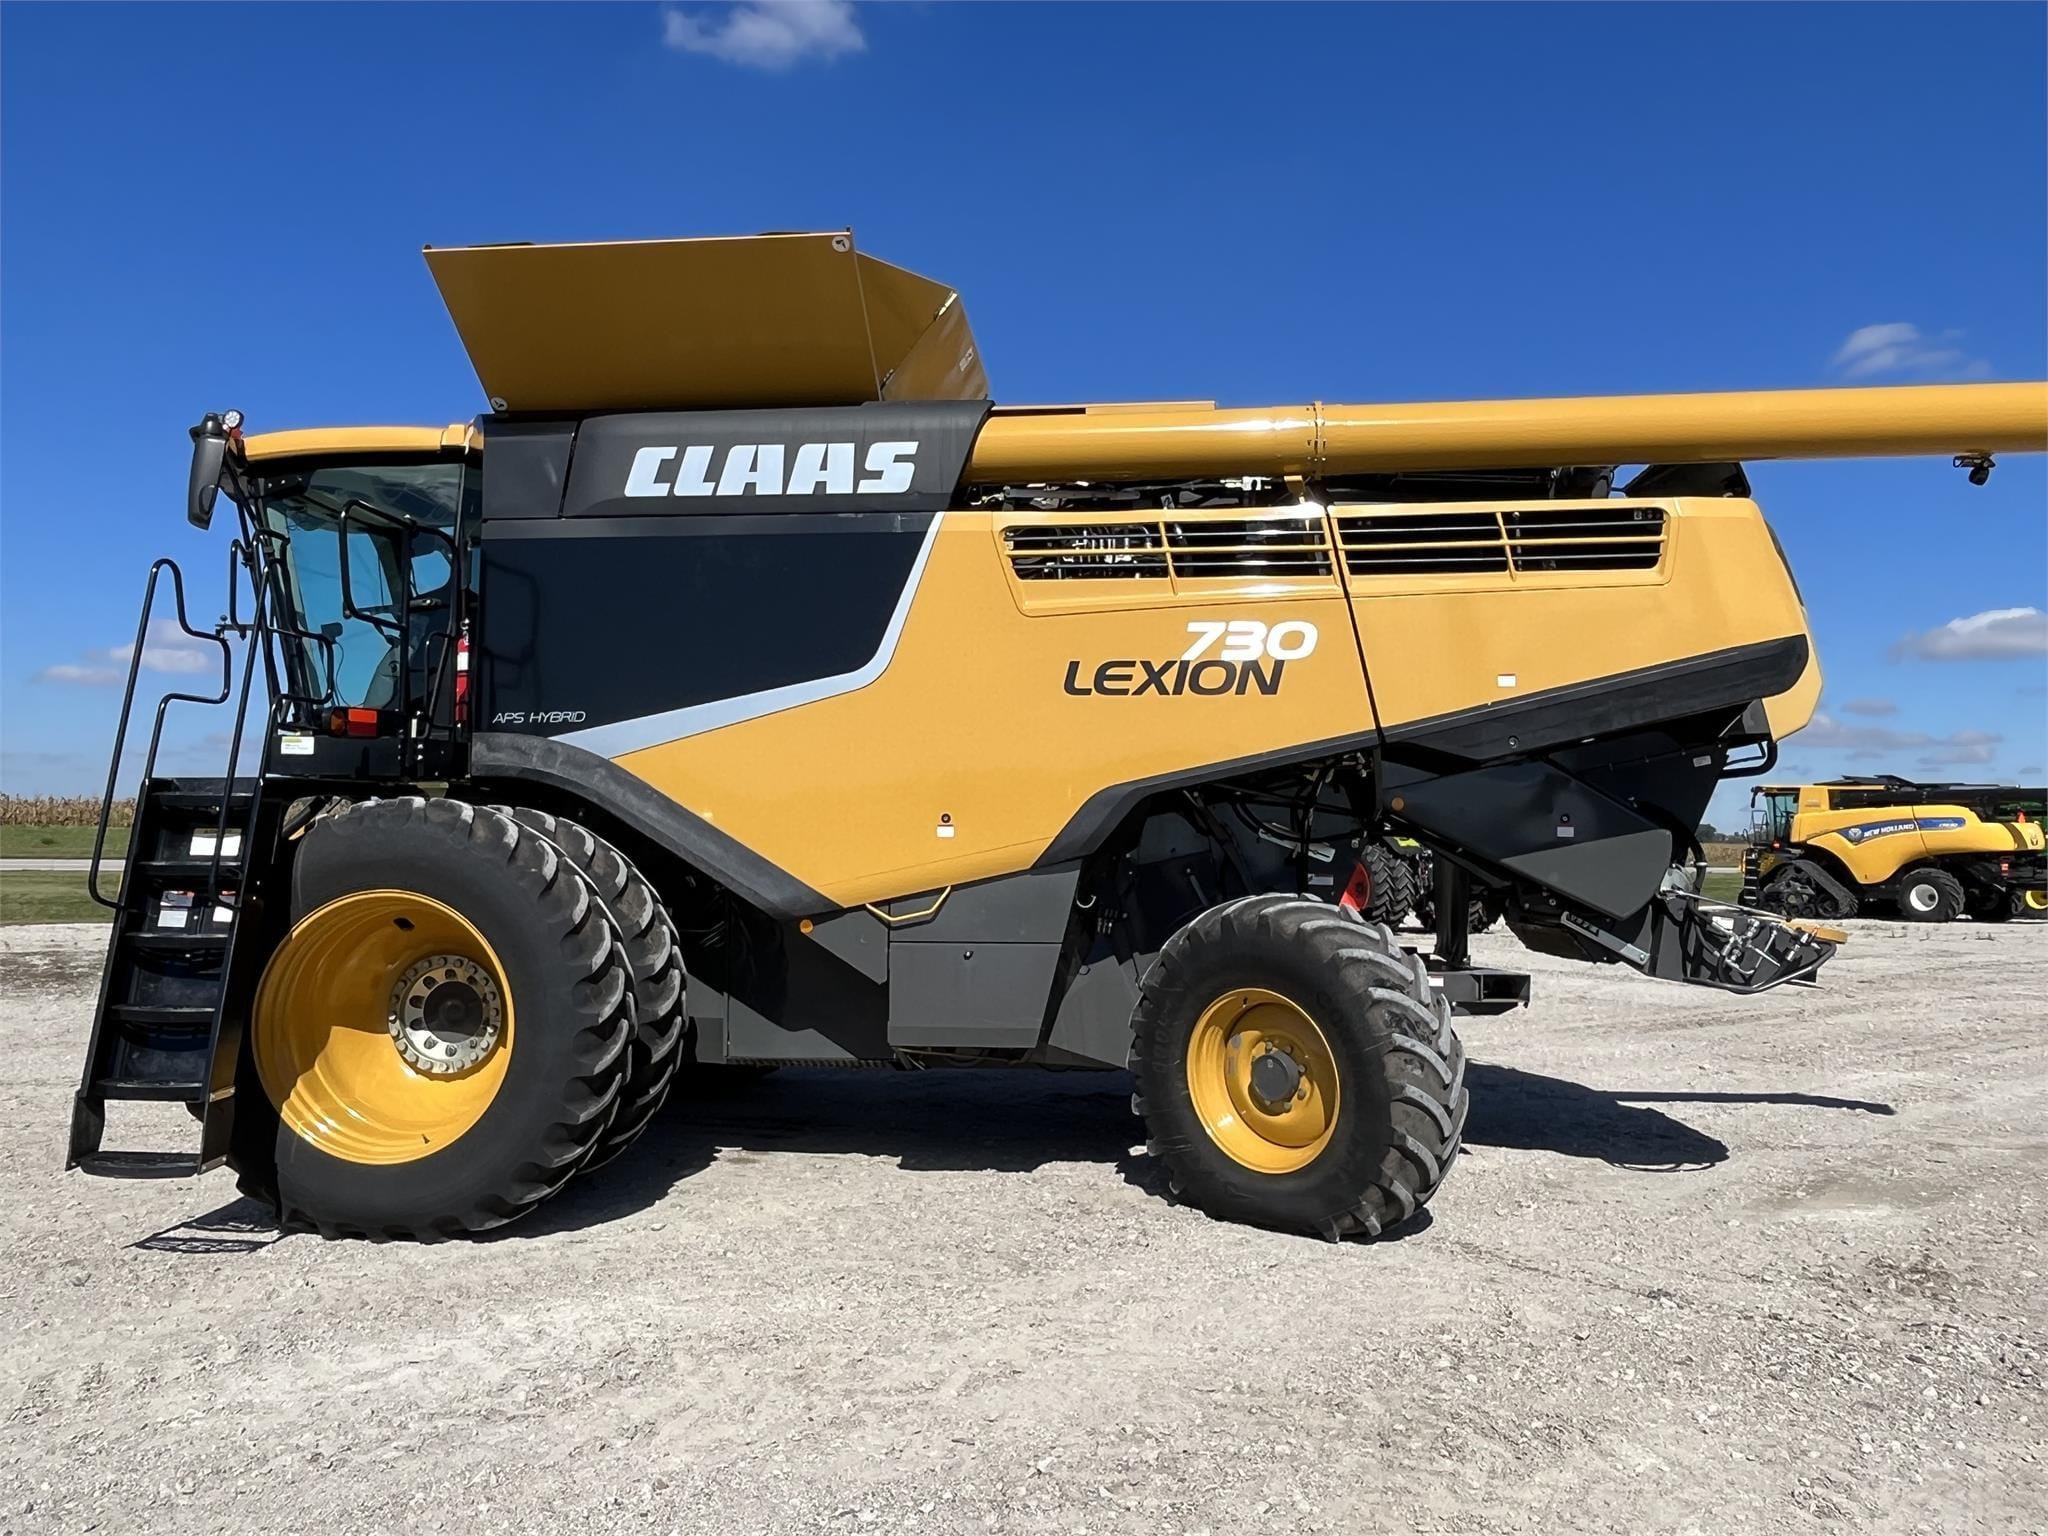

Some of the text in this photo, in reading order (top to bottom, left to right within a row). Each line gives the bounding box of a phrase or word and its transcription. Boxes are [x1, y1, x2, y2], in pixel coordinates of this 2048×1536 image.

[623, 441, 919, 497] CLAAS
[1180, 620, 1319, 661] 730
[1063, 659, 1286, 696] LEXION
[492, 710, 587, 724] APS HYBRID
[1863, 824, 1915, 837] NEW HOLLAND
